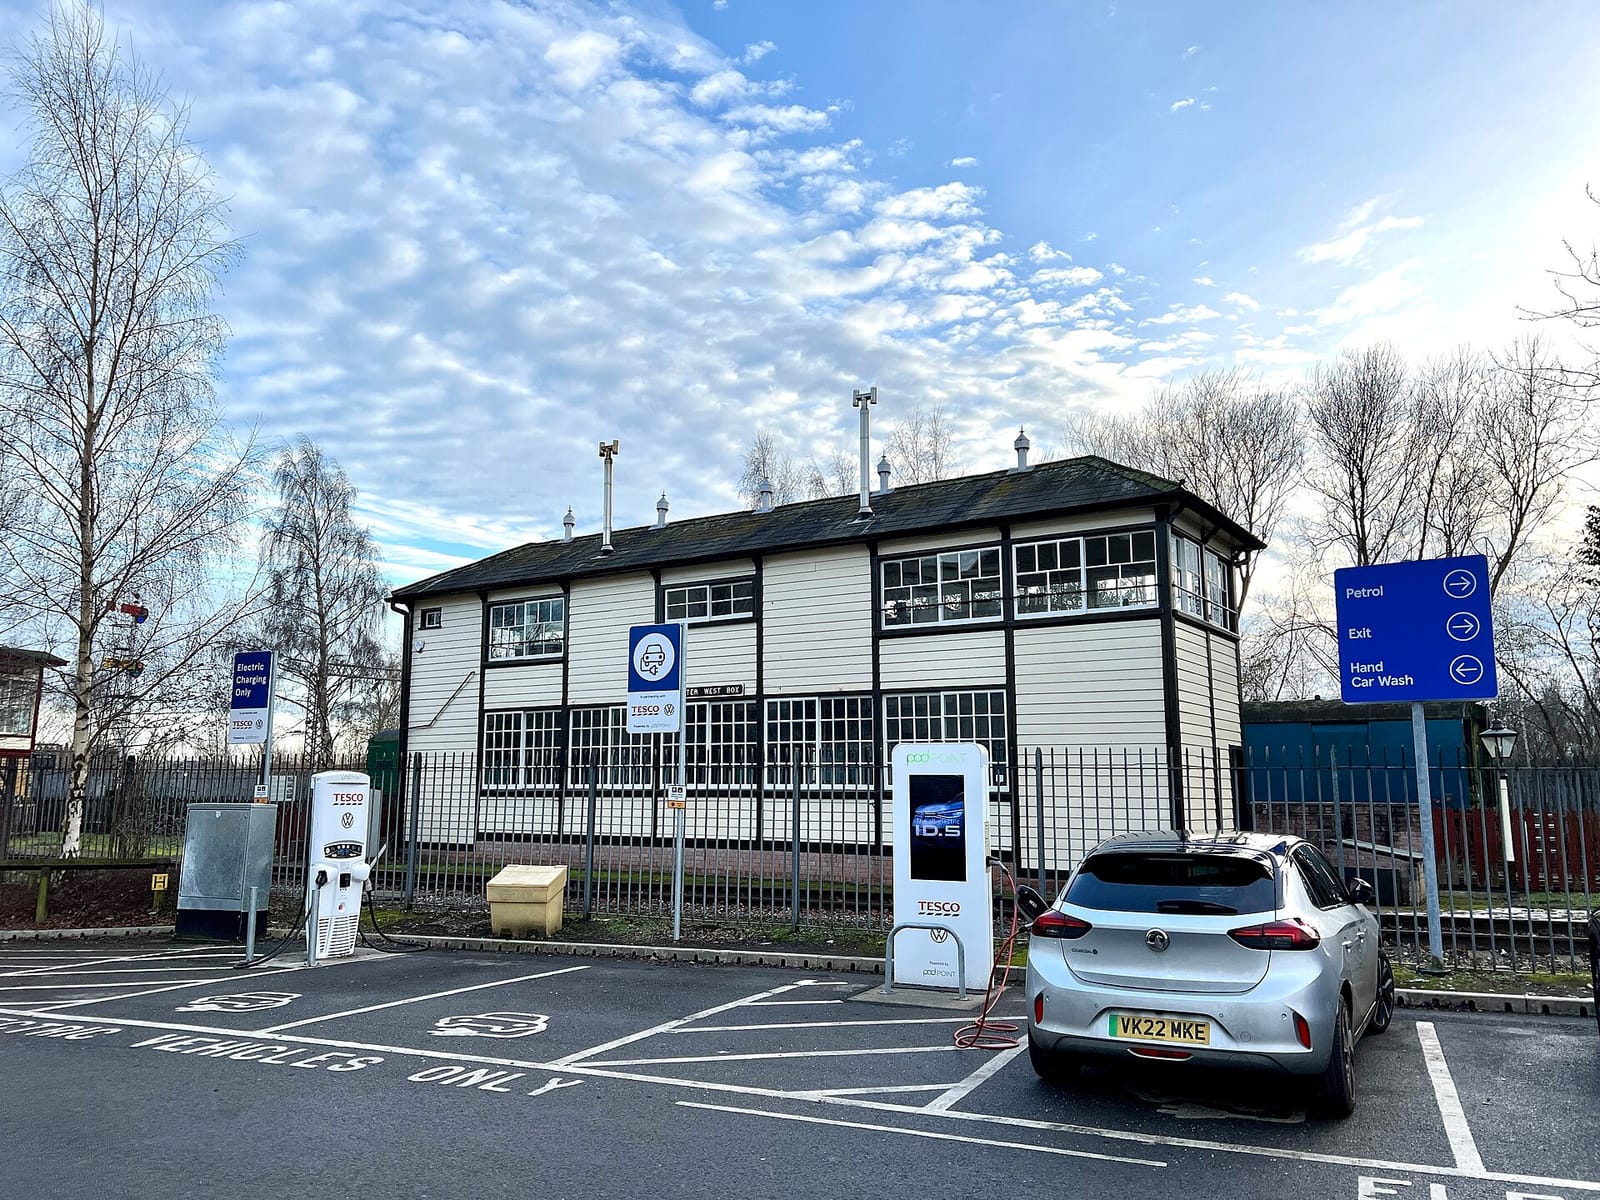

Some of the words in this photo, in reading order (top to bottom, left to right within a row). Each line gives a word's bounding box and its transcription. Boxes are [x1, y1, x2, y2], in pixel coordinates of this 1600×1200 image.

[1346, 585, 1384, 599] Petrol
[1348, 627, 1372, 639] Exit
[236, 663, 265, 672] Electric
[1350, 661, 1384, 673] Hand
[236, 675, 267, 685] Charging
[1351, 676, 1374, 688] Car
[1377, 675, 1414, 687] Wash
[235, 688, 252, 698] Only
[686, 688, 699, 696] TER
[703, 687, 721, 695] WEST
[726, 686, 740, 694] BOX
[631, 705, 660, 713] TESCO
[333, 793, 364, 802] TESCO
[915, 824, 961, 837] ID.5
[154, 875, 165, 888] H
[918, 901, 961, 912] TESCO
[1121, 1017, 1165, 1037] VK22
[1171, 1021, 1206, 1041] MKE
[130, 1034, 385, 1072] VEHICLES
[406, 1066, 585, 1096] ONLY
